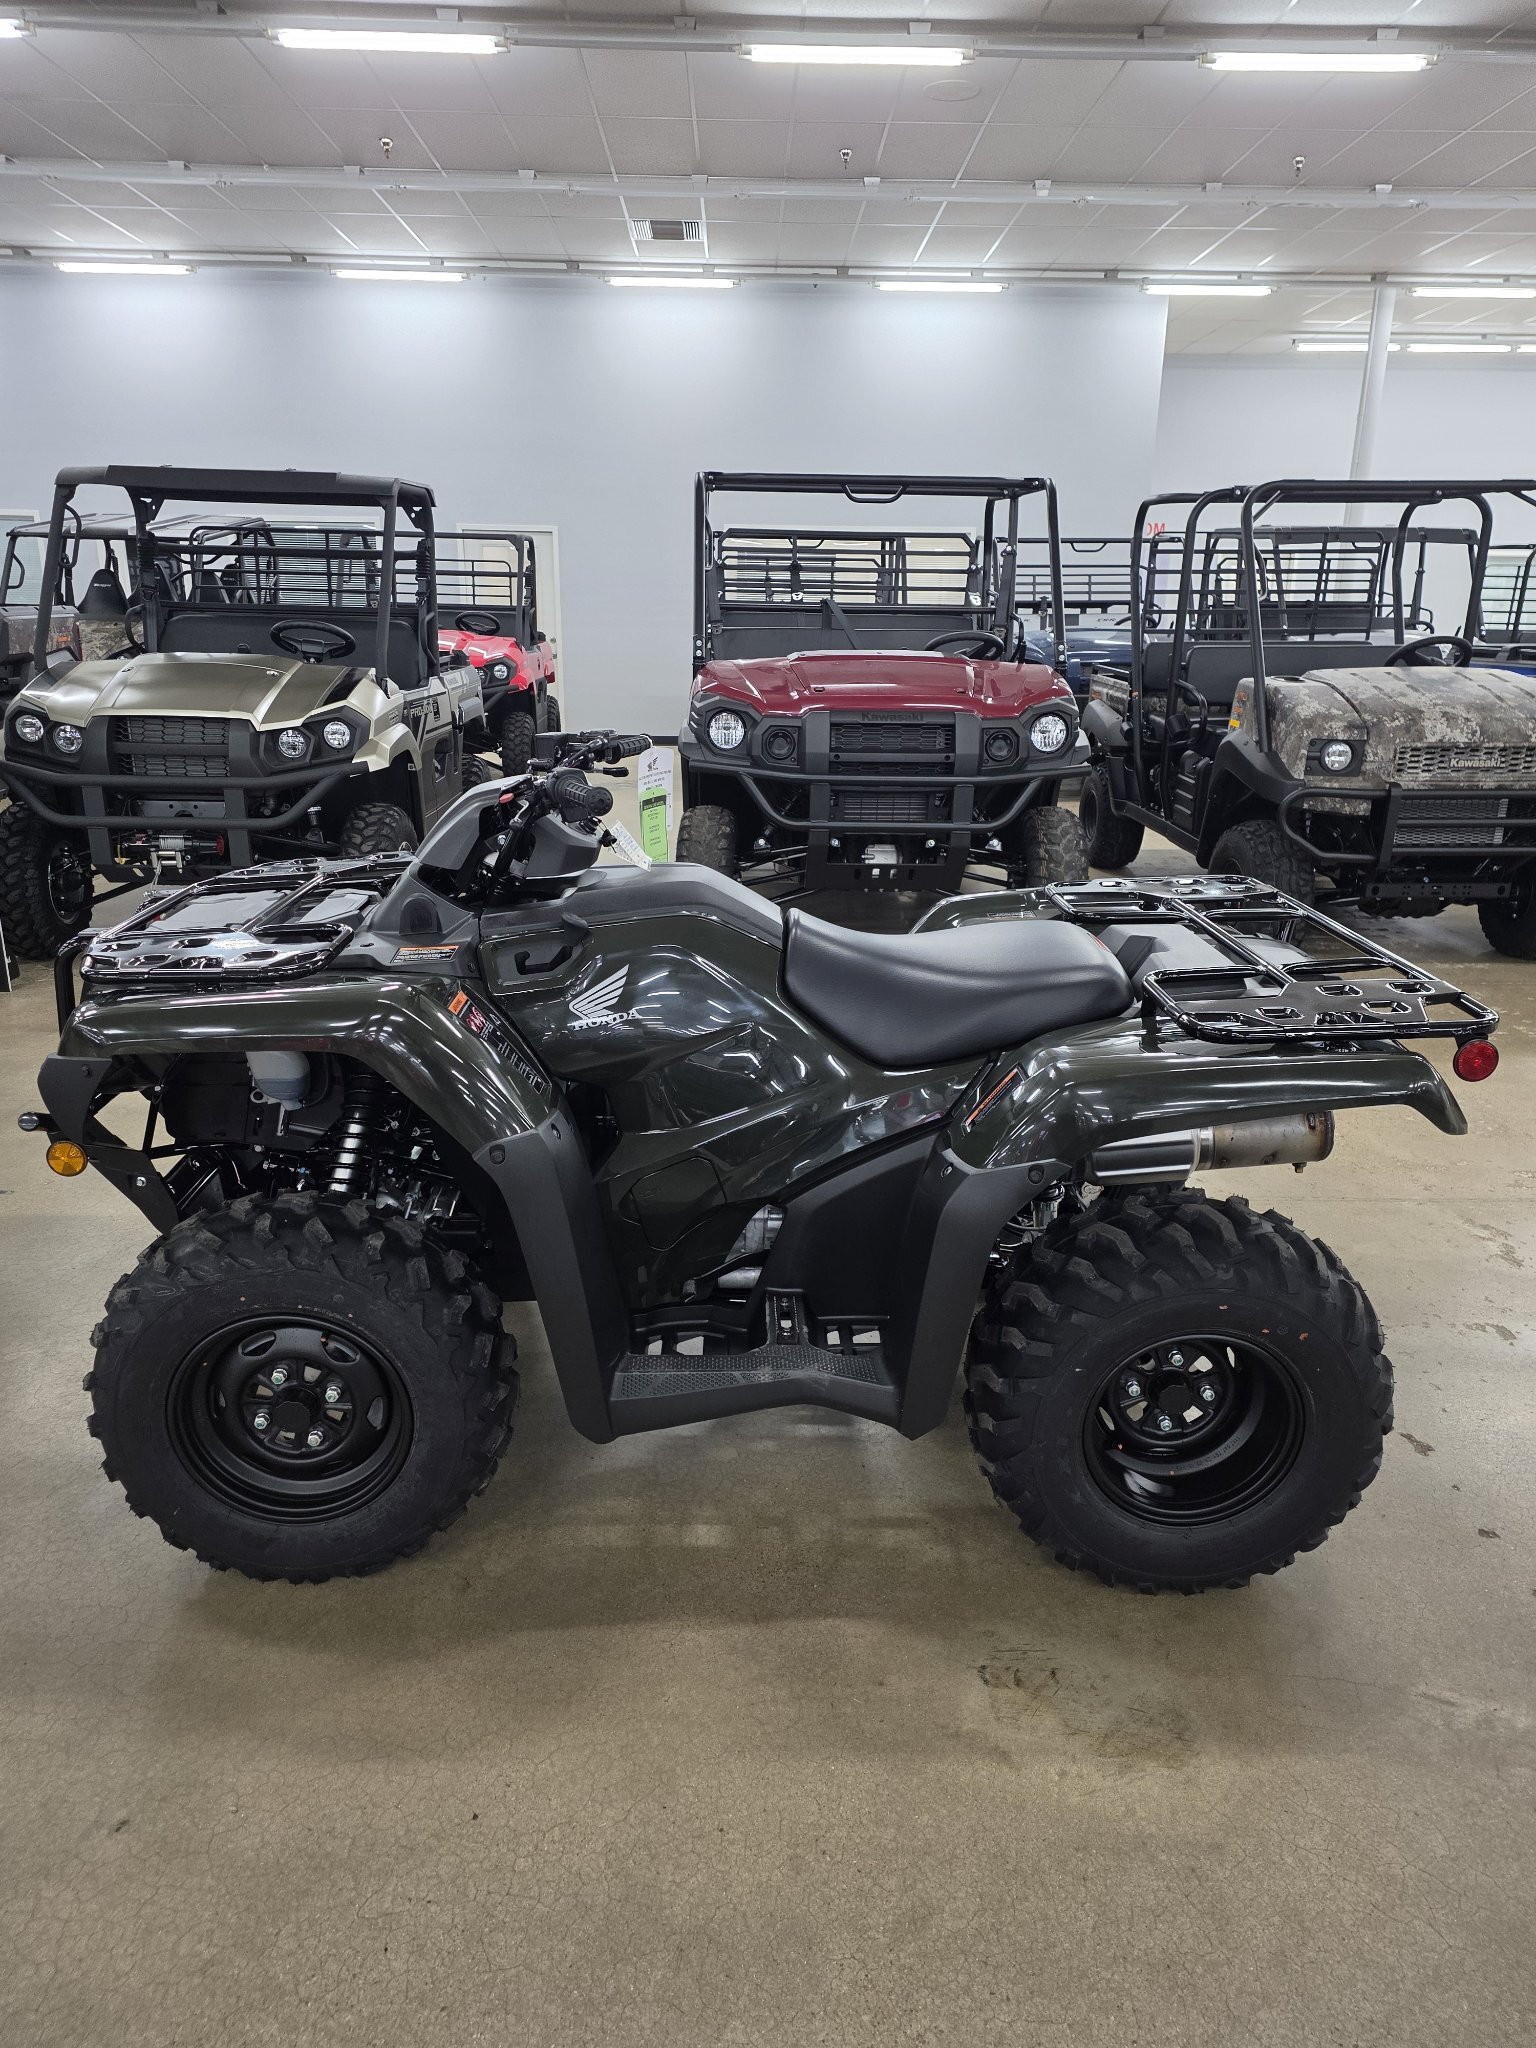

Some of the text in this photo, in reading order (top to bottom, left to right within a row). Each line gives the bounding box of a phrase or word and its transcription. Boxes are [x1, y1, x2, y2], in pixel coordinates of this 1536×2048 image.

[861, 711, 924, 721] Kawasaki
[1450, 757, 1501, 768] Kawasaki
[570, 1009, 642, 1031] HONDA
